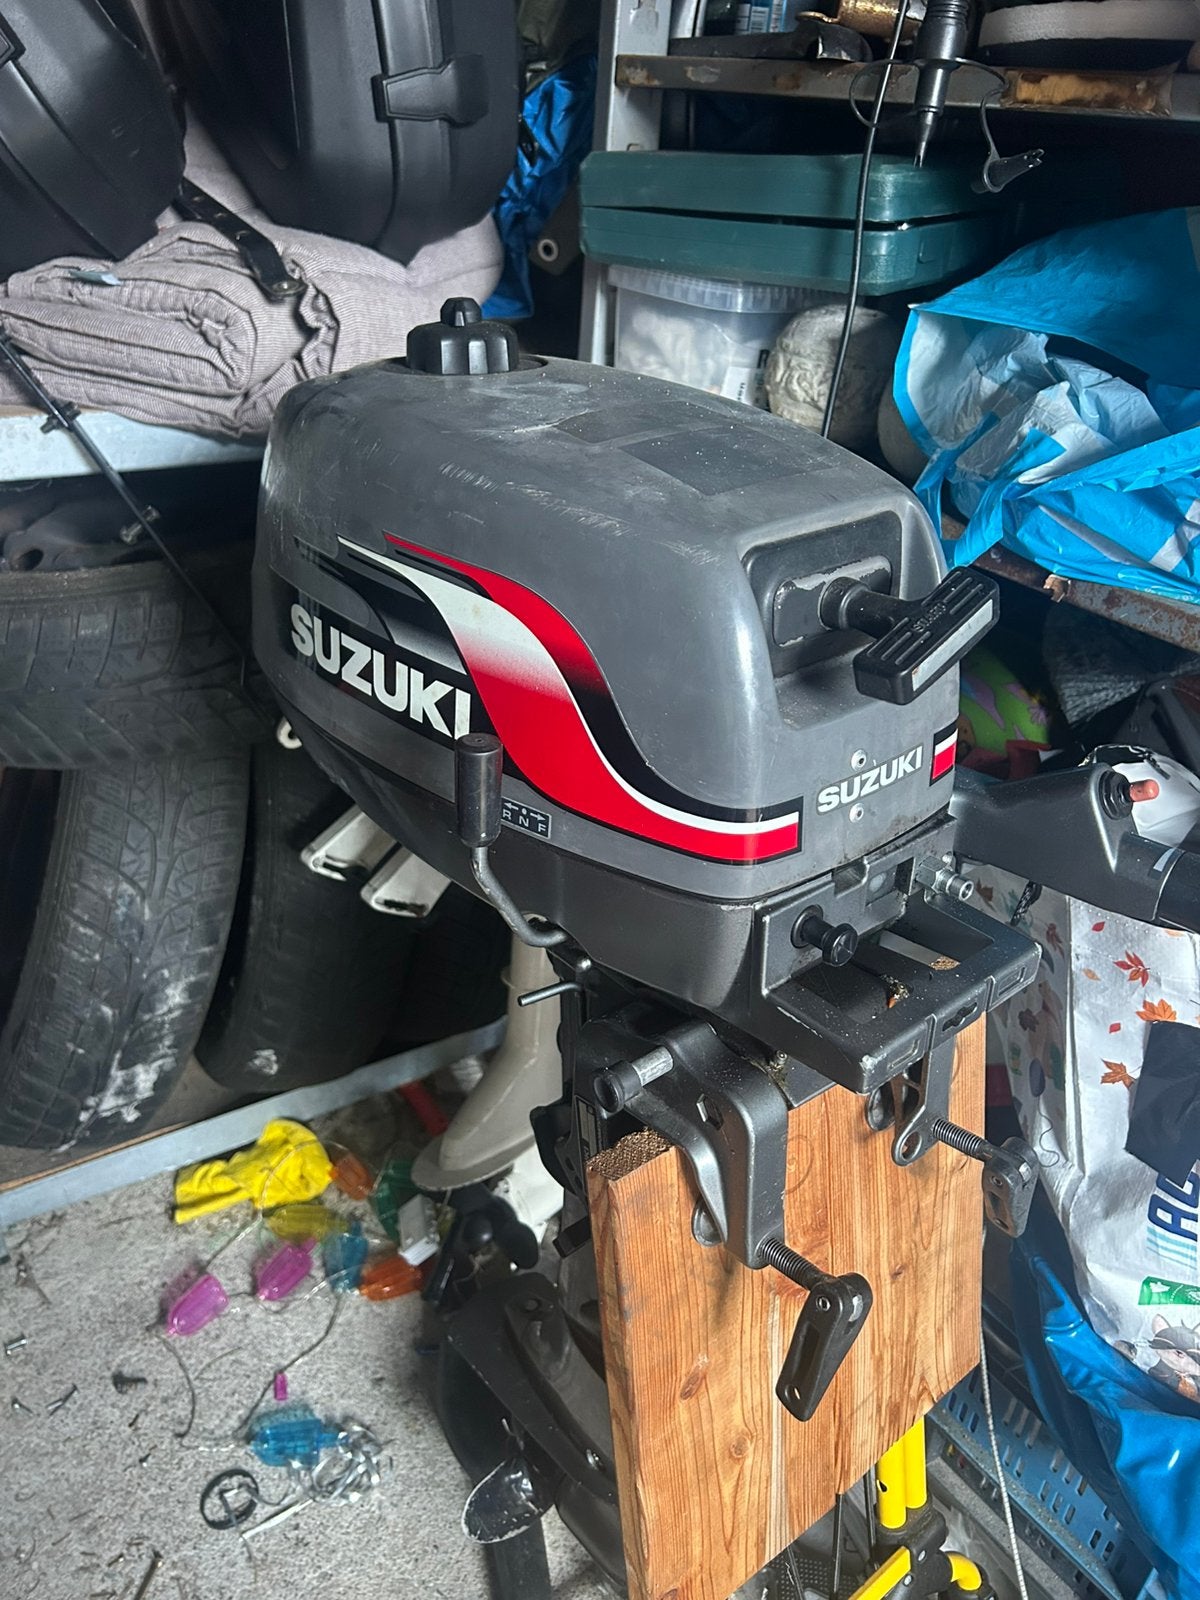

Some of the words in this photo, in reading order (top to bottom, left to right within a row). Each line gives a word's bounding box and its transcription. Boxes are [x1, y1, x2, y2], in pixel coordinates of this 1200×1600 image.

[290, 603, 471, 740] SUZUKI
[818, 745, 923, 813] SUZUKI
[503, 809, 511, 820] R
[519, 815, 529, 827] N
[538, 823, 547, 832] F
